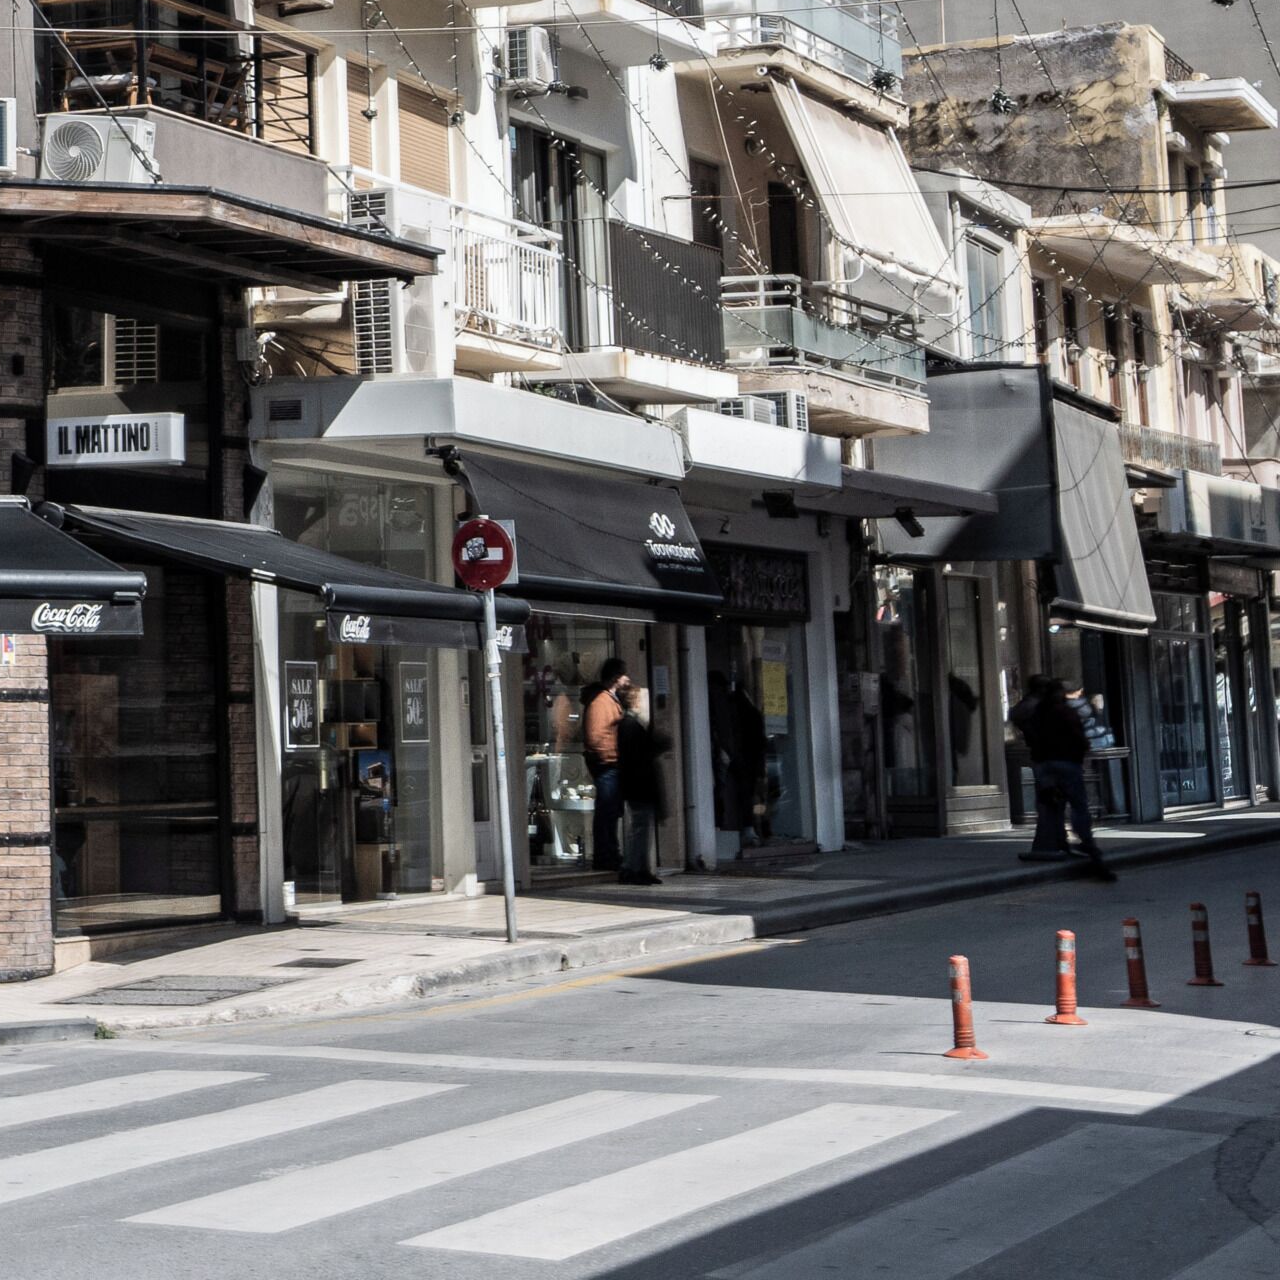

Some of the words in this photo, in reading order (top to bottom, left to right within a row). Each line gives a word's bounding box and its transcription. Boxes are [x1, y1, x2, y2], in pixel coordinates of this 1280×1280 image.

[58, 426, 72, 455] IL
[75, 422, 151, 454] MATTINO
[31, 602, 103, 632] Coca-Cola
[291, 679, 313, 695] SALE
